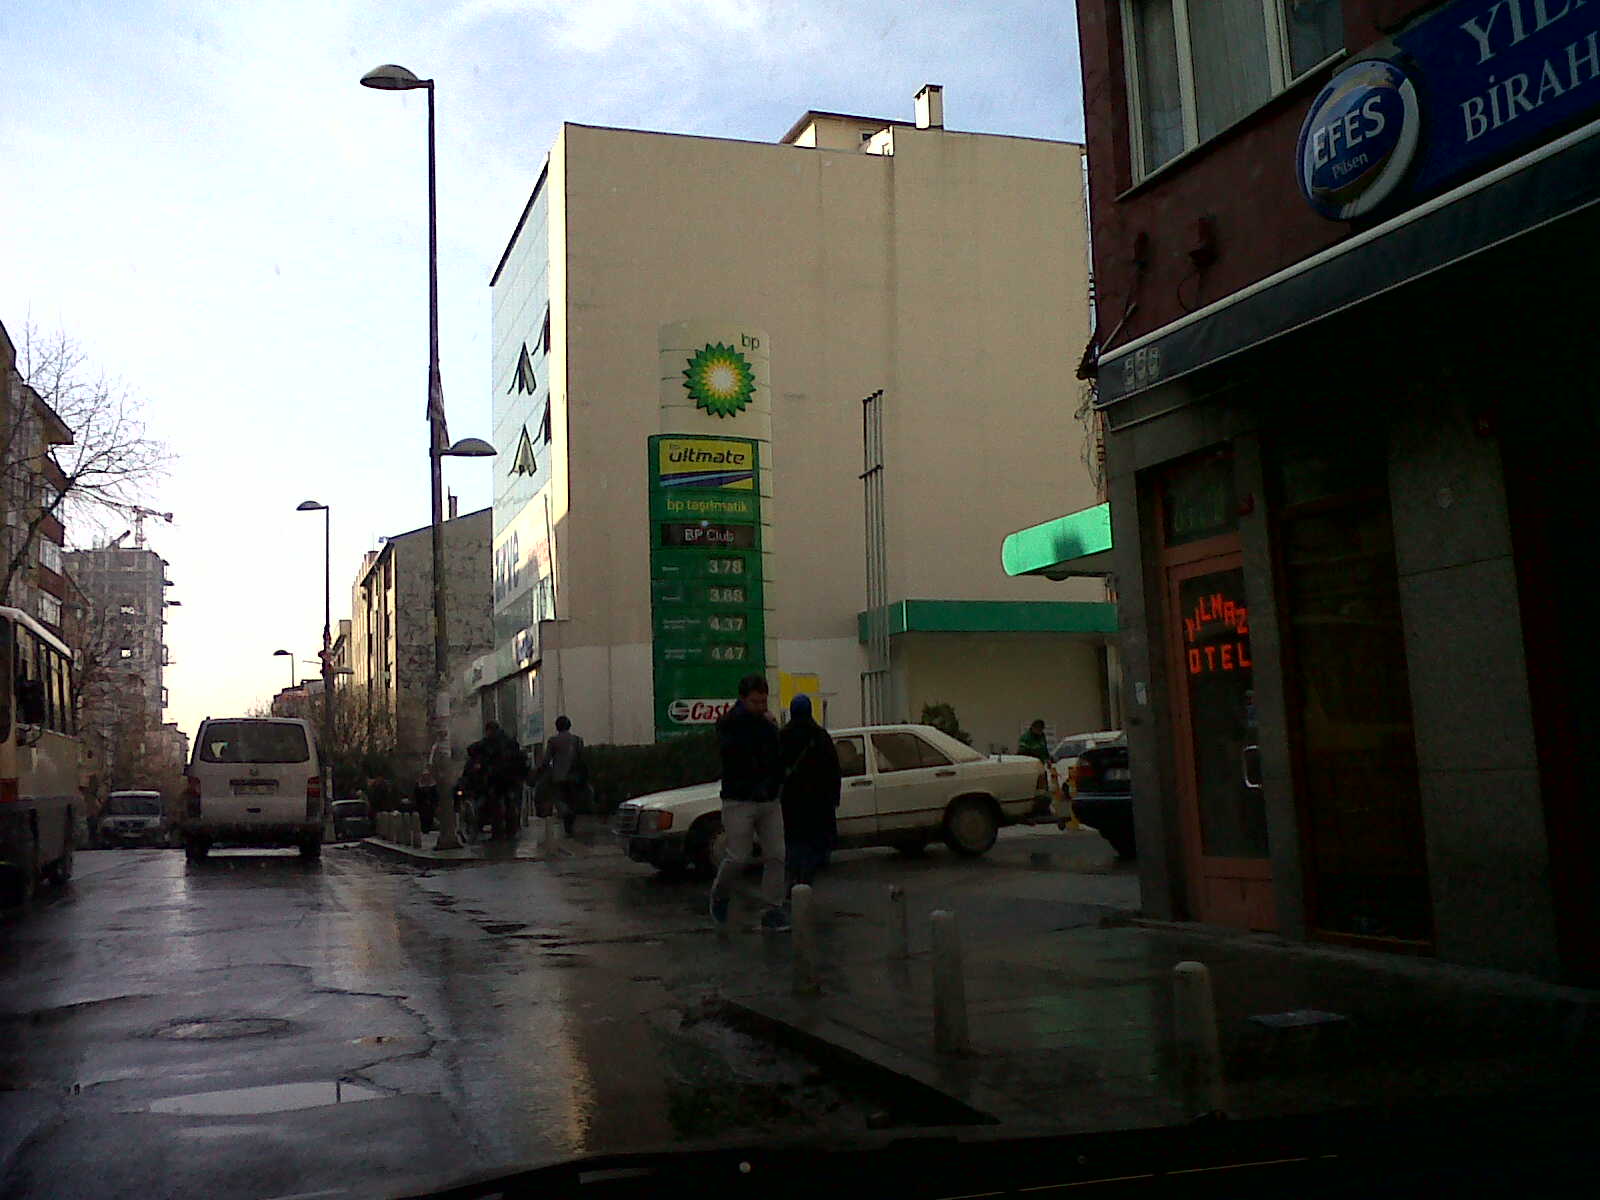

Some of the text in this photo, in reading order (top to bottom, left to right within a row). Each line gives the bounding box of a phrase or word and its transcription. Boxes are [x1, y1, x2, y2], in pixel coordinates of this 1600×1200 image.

[1312, 95, 1386, 170] EFES
[1331, 152, 1369, 180] Pilsen
[741, 333, 759, 351] bp
[706, 528, 735, 544] Club
[1188, 643, 1252, 675] OTEL
[691, 703, 731, 721] Cast
